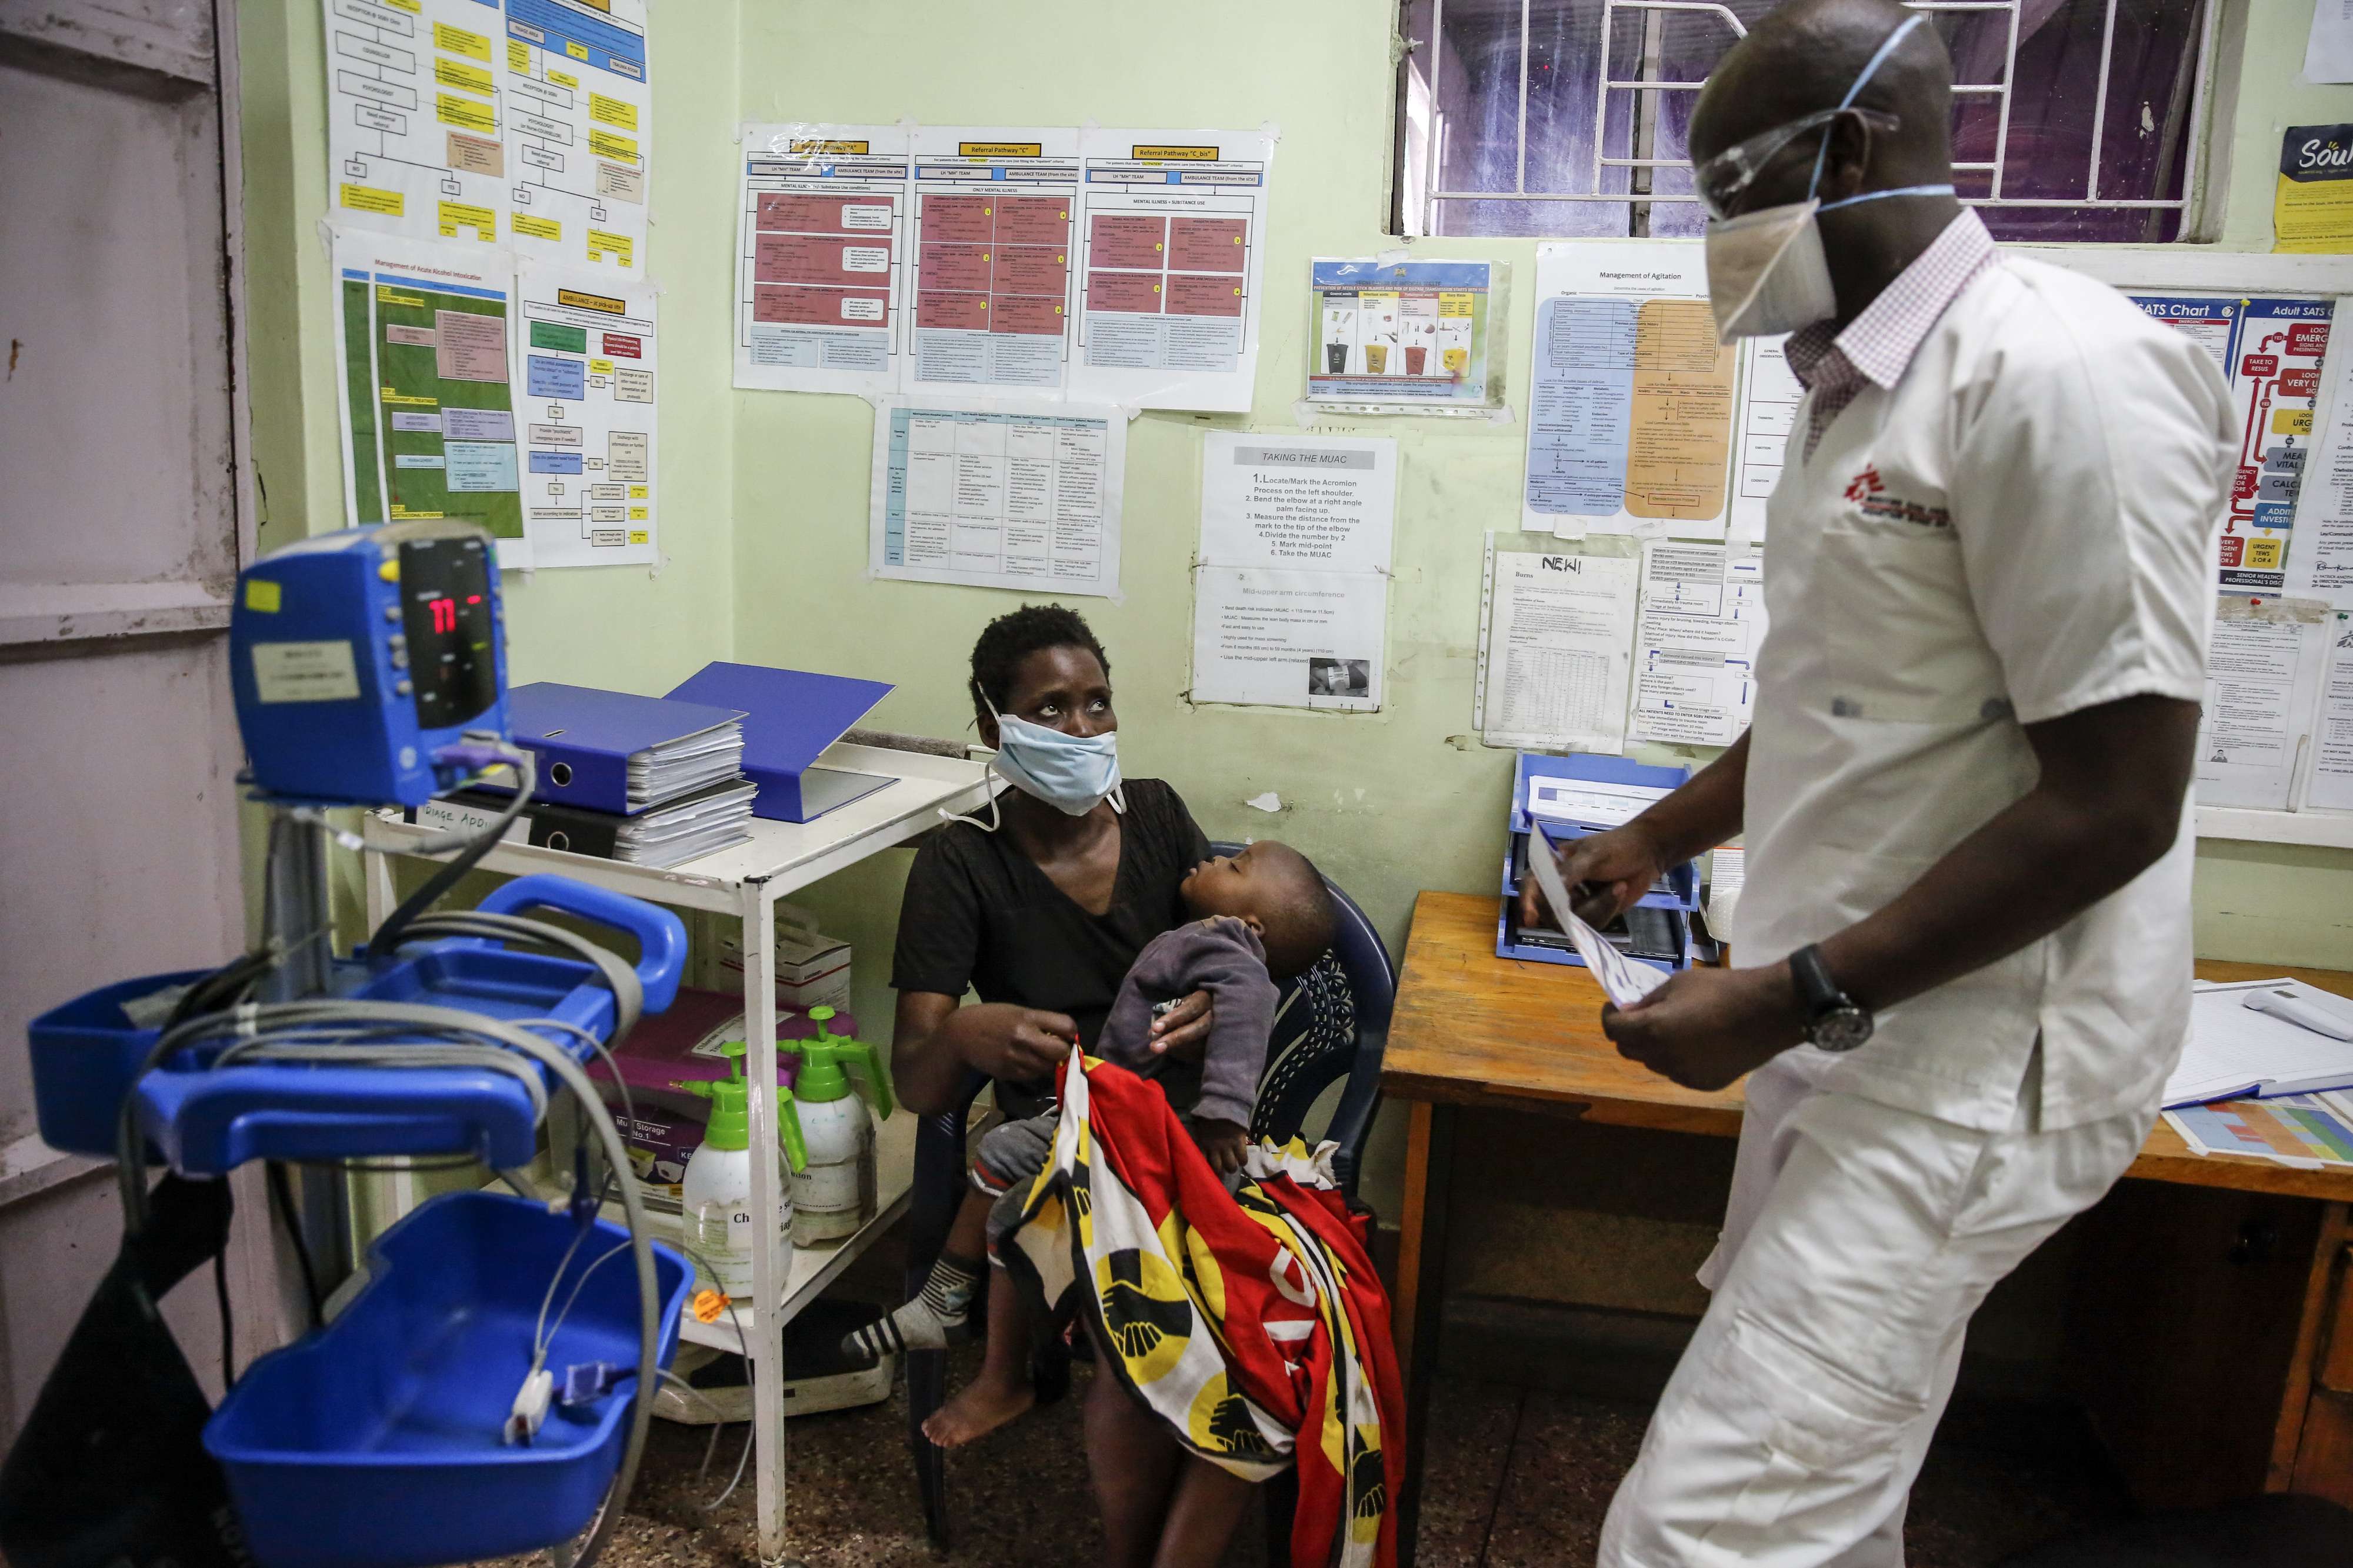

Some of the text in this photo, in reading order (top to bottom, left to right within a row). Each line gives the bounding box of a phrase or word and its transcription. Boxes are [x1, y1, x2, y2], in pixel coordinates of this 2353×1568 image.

[375, 259, 409, 270] Management
[454, 272, 482, 281] Intoxication
[1600, 272, 1641, 281] Management
[563, 294, 589, 304] AMBULANCE
[2170, 305, 2209, 316] Chart
[2272, 306, 2325, 316] Adult SATS
[1262, 453, 1347, 463] TAKING THE MUAC
[1542, 556, 1581, 574] NEW!
[636, 1123, 665, 1135] Storage
